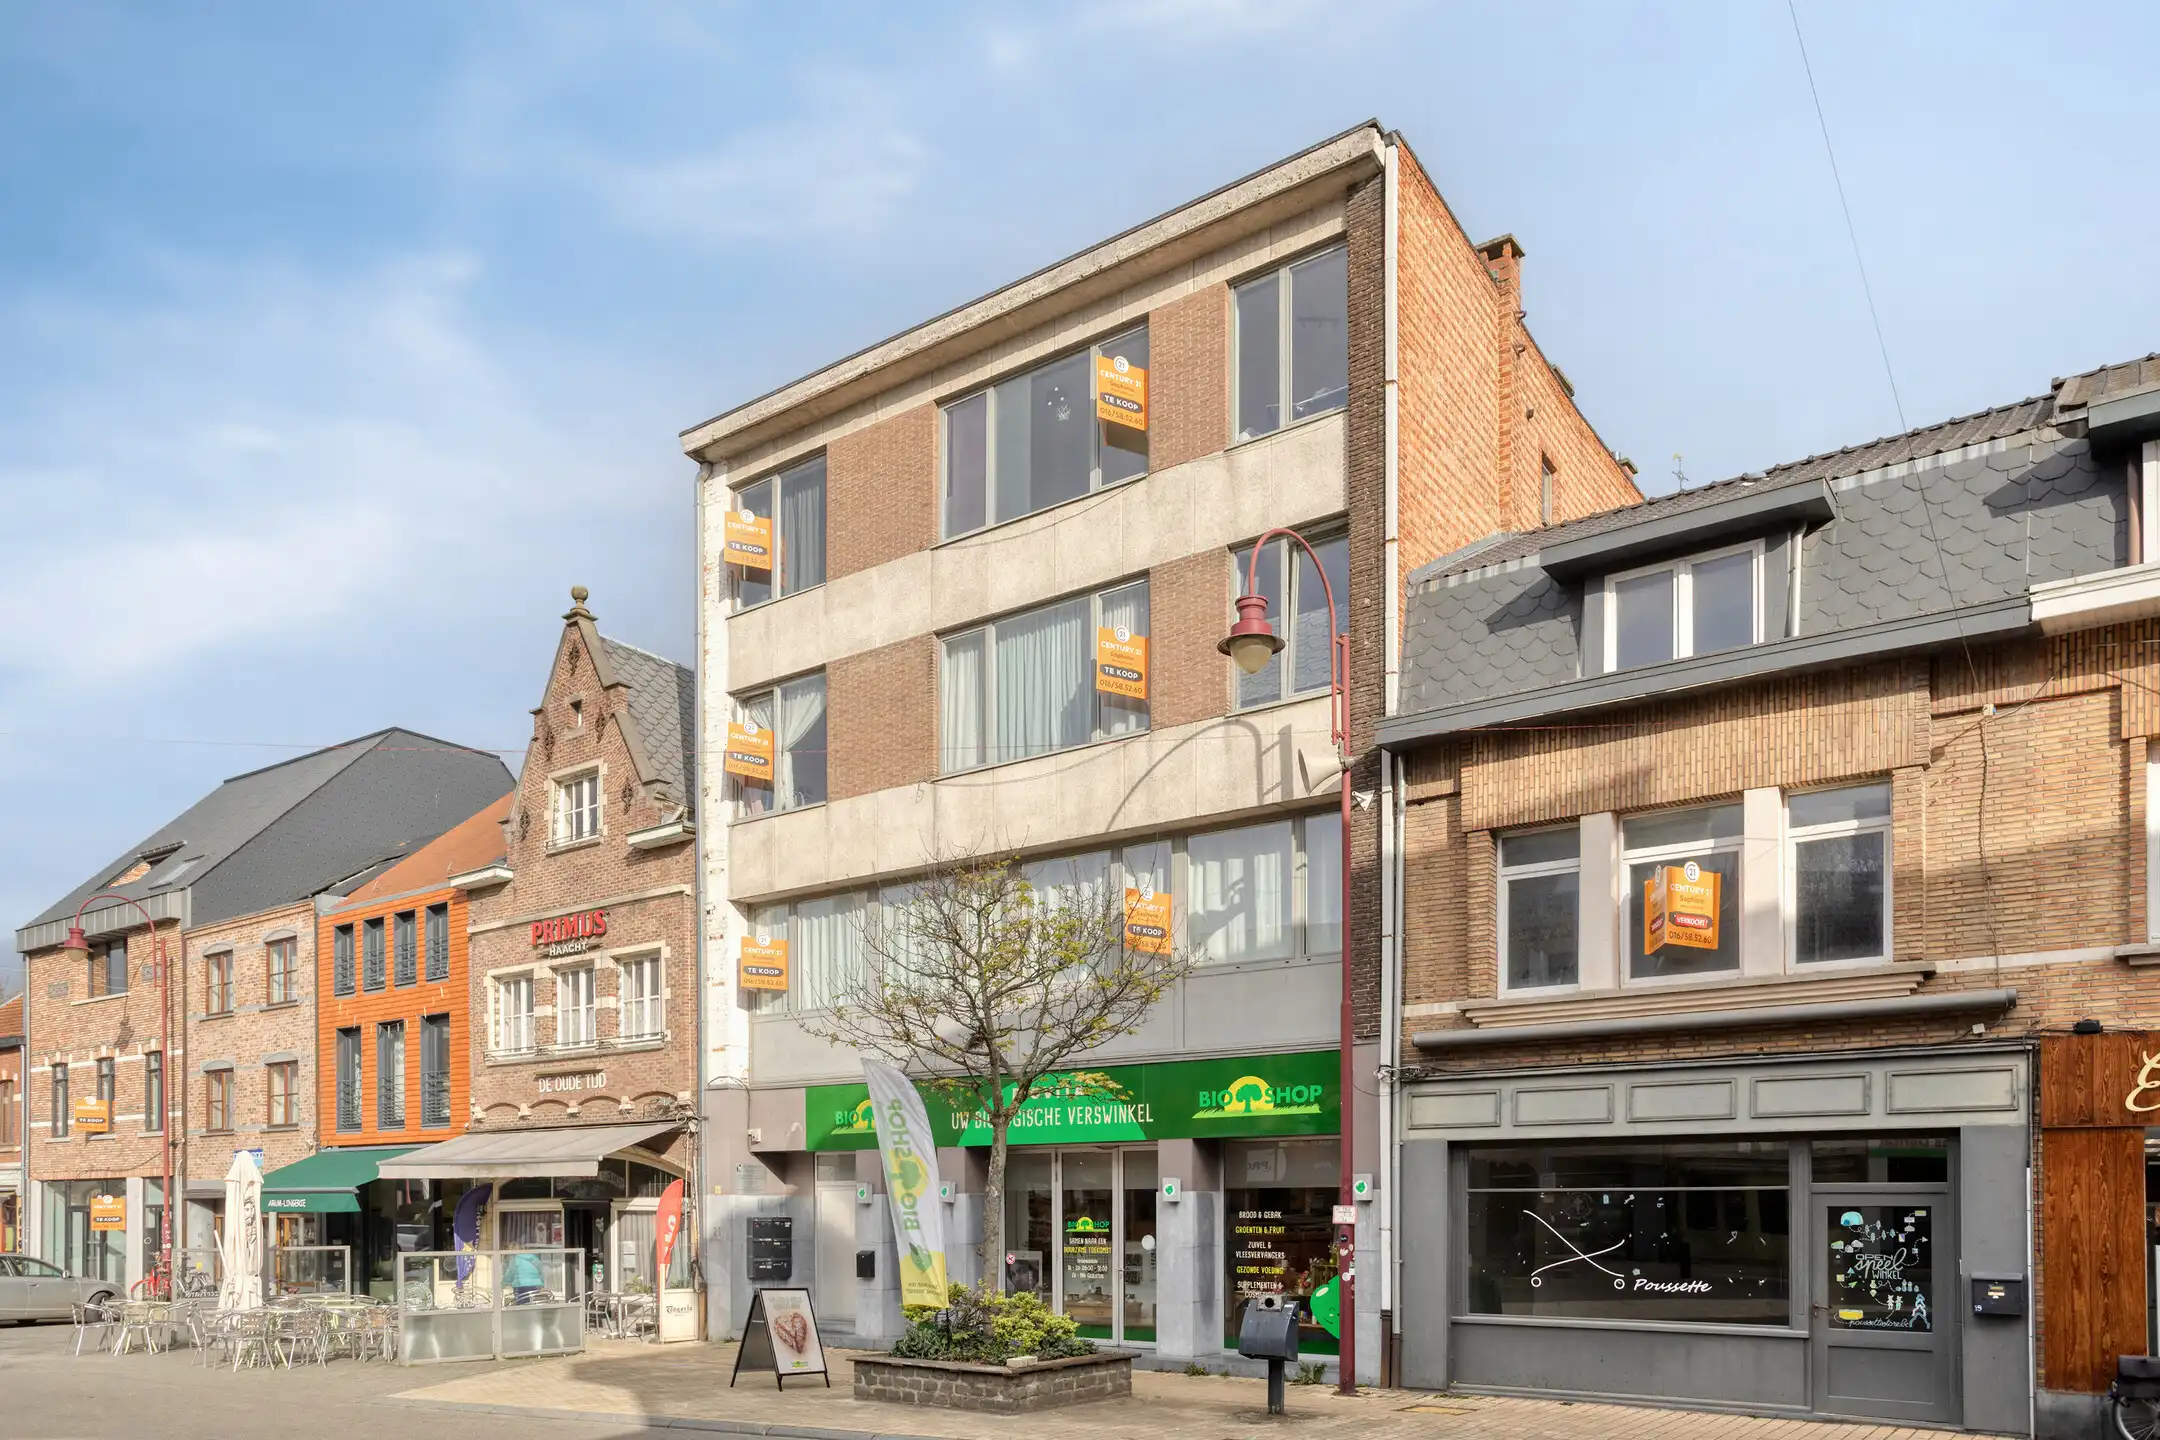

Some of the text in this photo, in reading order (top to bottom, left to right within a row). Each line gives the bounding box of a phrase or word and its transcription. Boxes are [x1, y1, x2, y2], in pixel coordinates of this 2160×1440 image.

[1100, 369, 1142, 388] CENTURY 21
[1104, 394, 1139, 410] TE KOOP
[1100, 407, 1143, 425] 016/58.52.60
[731, 542, 764, 554] TE KOOP
[1101, 641, 1133, 653] CENTURY
[1104, 667, 1138, 680] TE KOOP
[1100, 679, 1143, 694] 016/58.52.60
[733, 752, 765, 764] TE KOOP
[1670, 883, 1712, 897] CENTURY 21
[531, 909, 607, 946] PRIMUS
[1676, 916, 1706, 926] VERKOCHT
[1142, 927, 1162, 936] KOOP
[1669, 931, 1712, 944] 016/58.52.60
[550, 942, 587, 956] HAACHT
[539, 1072, 607, 1093] DE OUDE TIJD
[1199, 1085, 1323, 1108] BIO SHOP
[835, 1110, 860, 1125] BIO
[952, 1112, 969, 1130] UW
[1068, 1103, 1154, 1126] VERSWINKEL
[1239, 1211, 1282, 1219] BROOD & GEBAK
[1235, 1226, 1263, 1234] GROENTEN
[1269, 1226, 1285, 1234] FRUIT
[1248, 1241, 1266, 1249] ZUIVEL
[1235, 1250, 1286, 1259] VLEESVERVANGERS
[1856, 1253, 1894, 1261] OPEN
[1855, 1247, 1907, 1279] speel
[1236, 1265, 1284, 1275] GEZONDE VOEDING
[1872, 1270, 1902, 1280] WINKEL
[1237, 1280, 1277, 1290] SUPPLEMENTEN
[1633, 1278, 1713, 1293] Poussette
